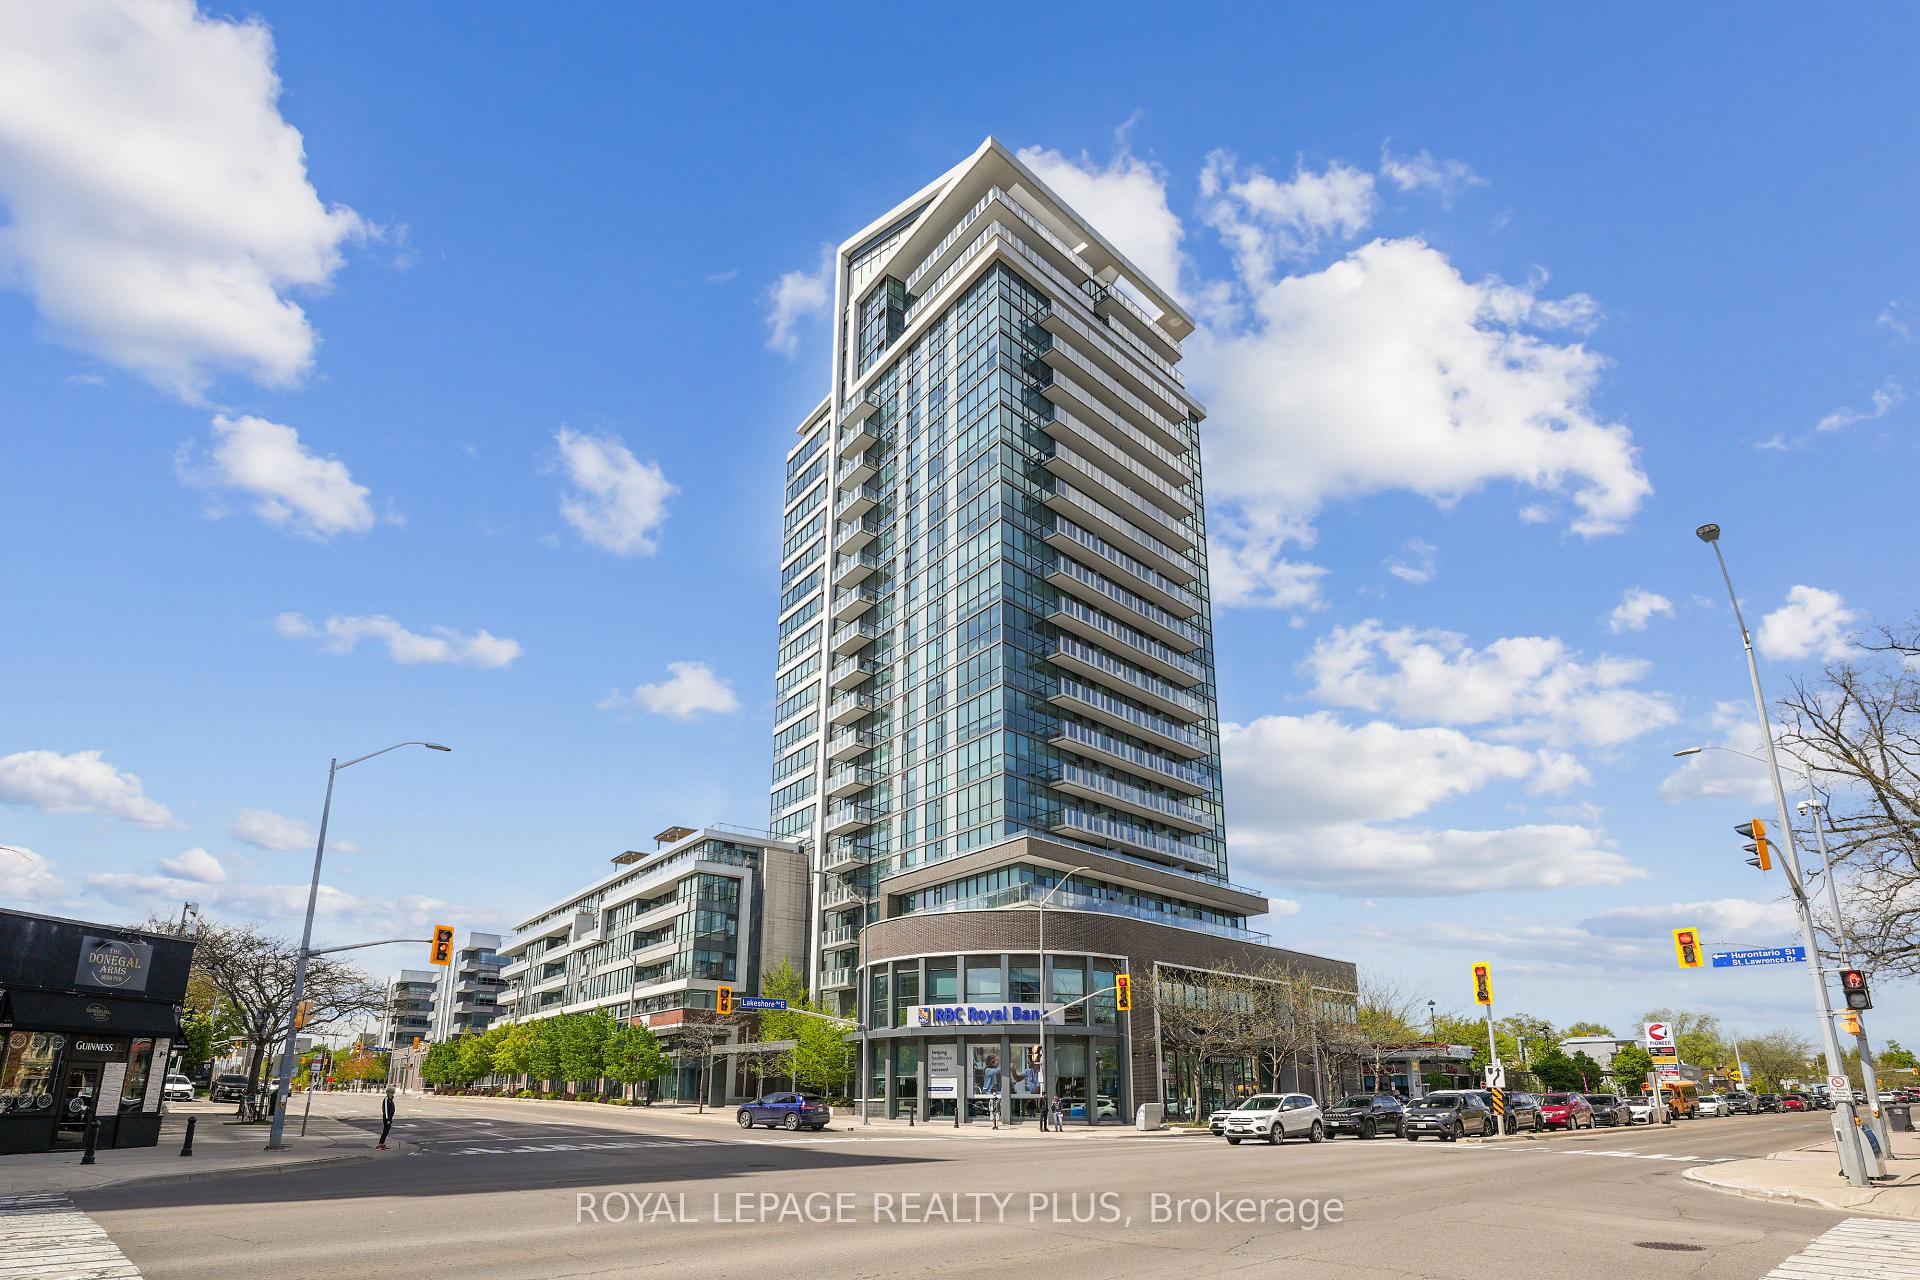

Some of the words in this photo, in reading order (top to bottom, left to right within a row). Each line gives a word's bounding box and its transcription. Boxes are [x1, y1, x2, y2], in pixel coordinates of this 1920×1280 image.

[1731, 949, 1780, 959] Hurontario
[89, 953, 141, 969] DONEGAL
[1745, 957, 1785, 965] Lawrence
[100, 965, 127, 975] ARMS
[743, 999, 775, 1007] Lakeshore
[935, 1007, 964, 1022] RBC
[967, 1006, 1008, 1024] Royal
[75, 1040, 114, 1052] GUINNESS
